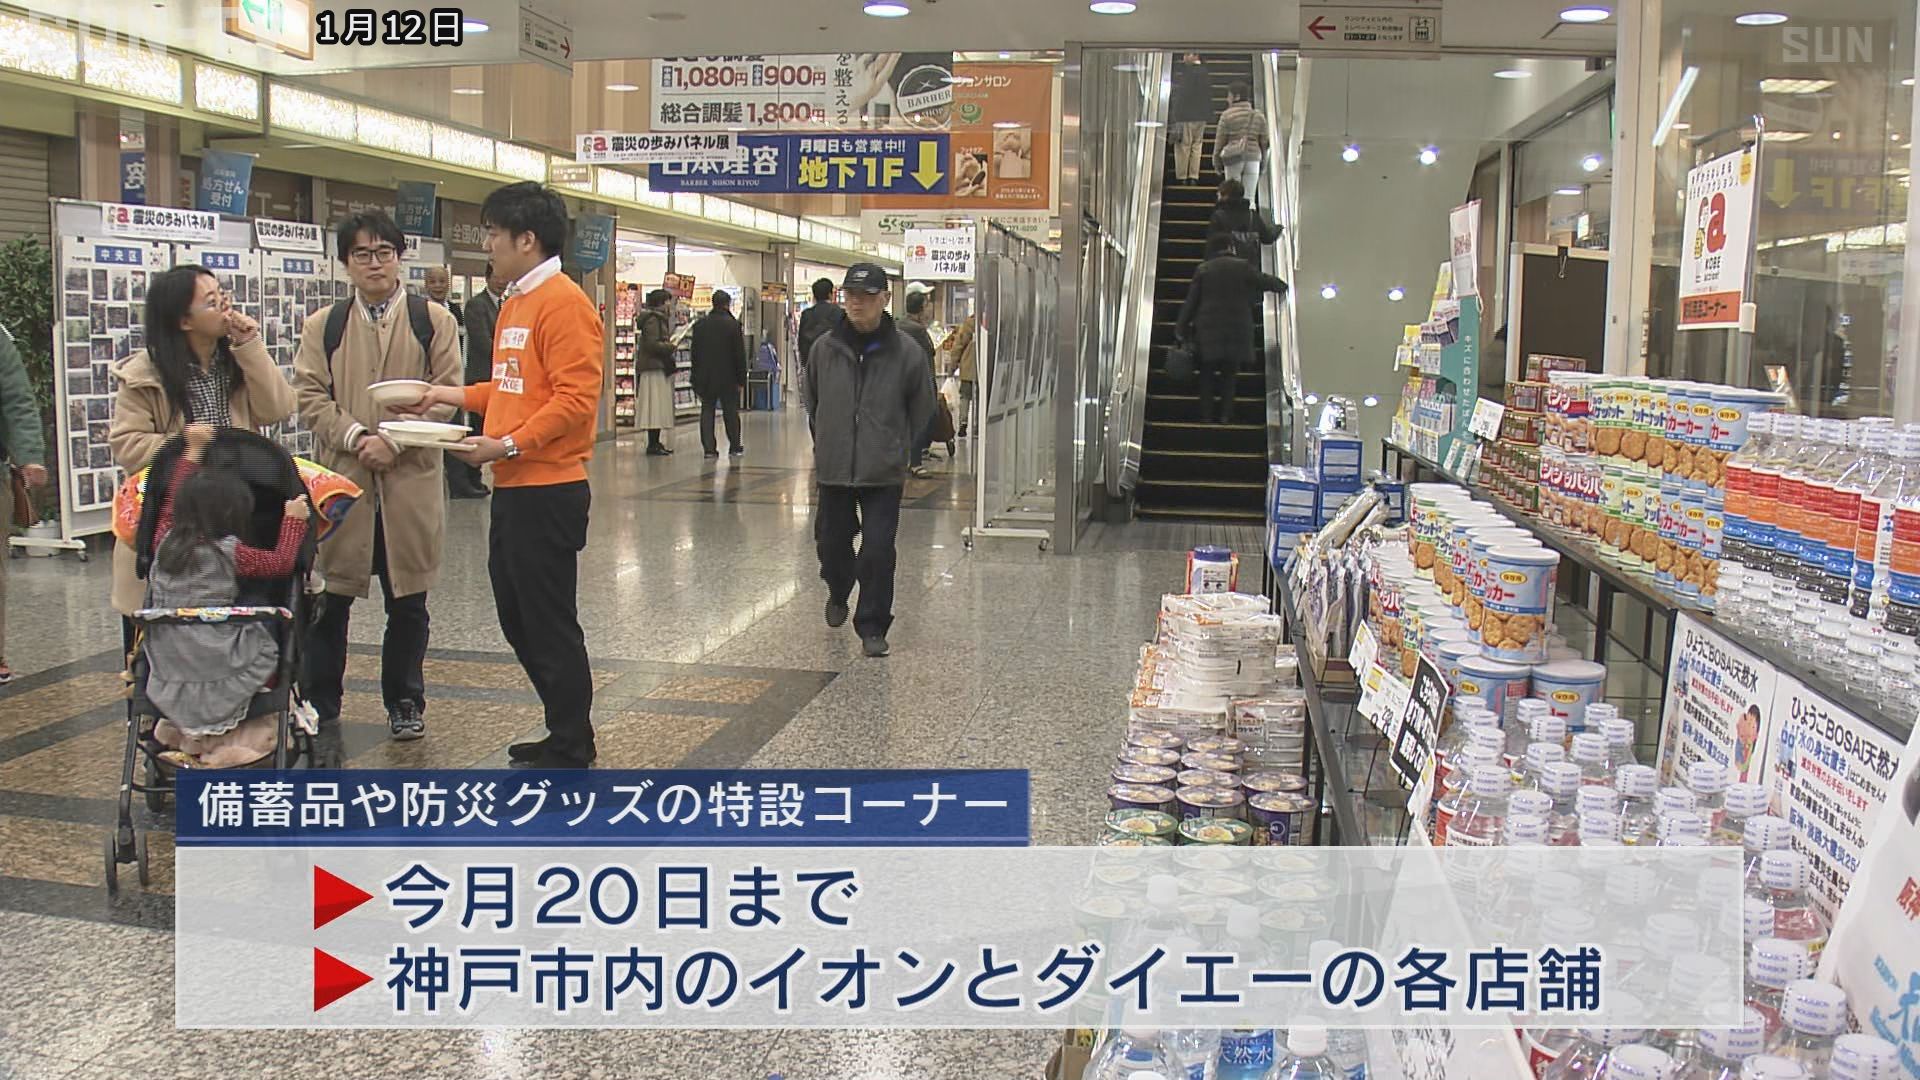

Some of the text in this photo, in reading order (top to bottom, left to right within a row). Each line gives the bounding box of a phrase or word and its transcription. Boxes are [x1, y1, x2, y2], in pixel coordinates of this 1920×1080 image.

[674, 66, 748, 91] 1,080円
[764, 65, 826, 87] 900円
[906, 87, 951, 109] BARBER
[660, 102, 826, 126] 総合調髪 1,800円
[611, 135, 730, 151] 震災の歩みパネル展
[800, 138, 906, 153] 月曜日も営業中!!
[798, 156, 904, 189] 地下1F
[210, 194, 233, 208] 受付
[132, 208, 216, 232] 震災の歩みパネル展
[256, 220, 318, 241] 震災の歩みパネル展
[101, 248, 138, 262] 中央区
[931, 250, 971, 261] 震災の歩み
[934, 262, 966, 273] パネル展
[1719, 411, 1737, 419] 保存用
[1503, 573, 1523, 582] 保存用
[1685, 630, 1760, 693] ひょうごBOSAI天然水
